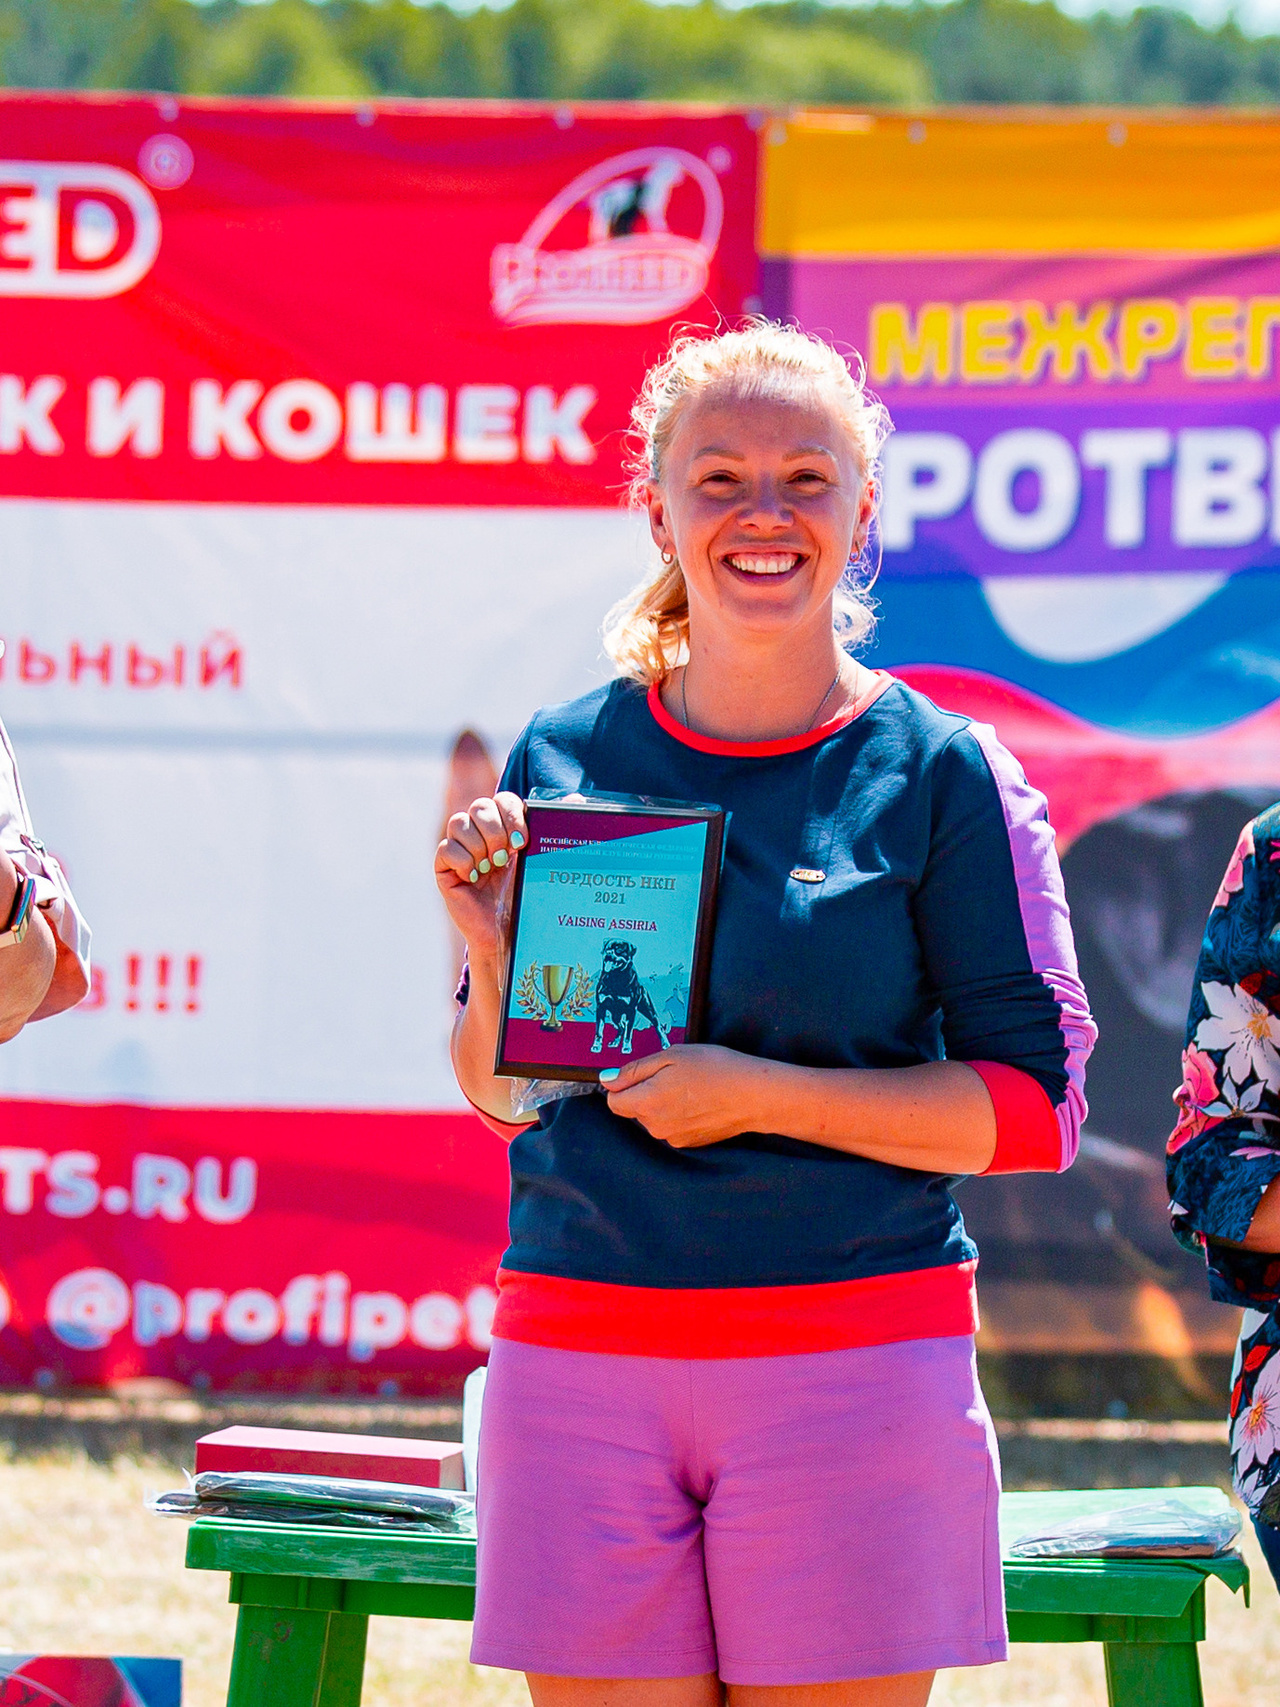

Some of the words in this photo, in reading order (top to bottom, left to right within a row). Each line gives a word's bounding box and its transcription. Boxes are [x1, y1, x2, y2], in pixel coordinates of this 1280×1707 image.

[86, 375, 165, 459] И
[188, 378, 598, 464] КОШЕК
[548, 870, 637, 888] ГОРДОСТЬ
[640, 876, 677, 890] НКП
[594, 891, 626, 905] 2021
[557, 914, 606, 928] VAISING
[608, 918, 658, 932] ASSIRIA
